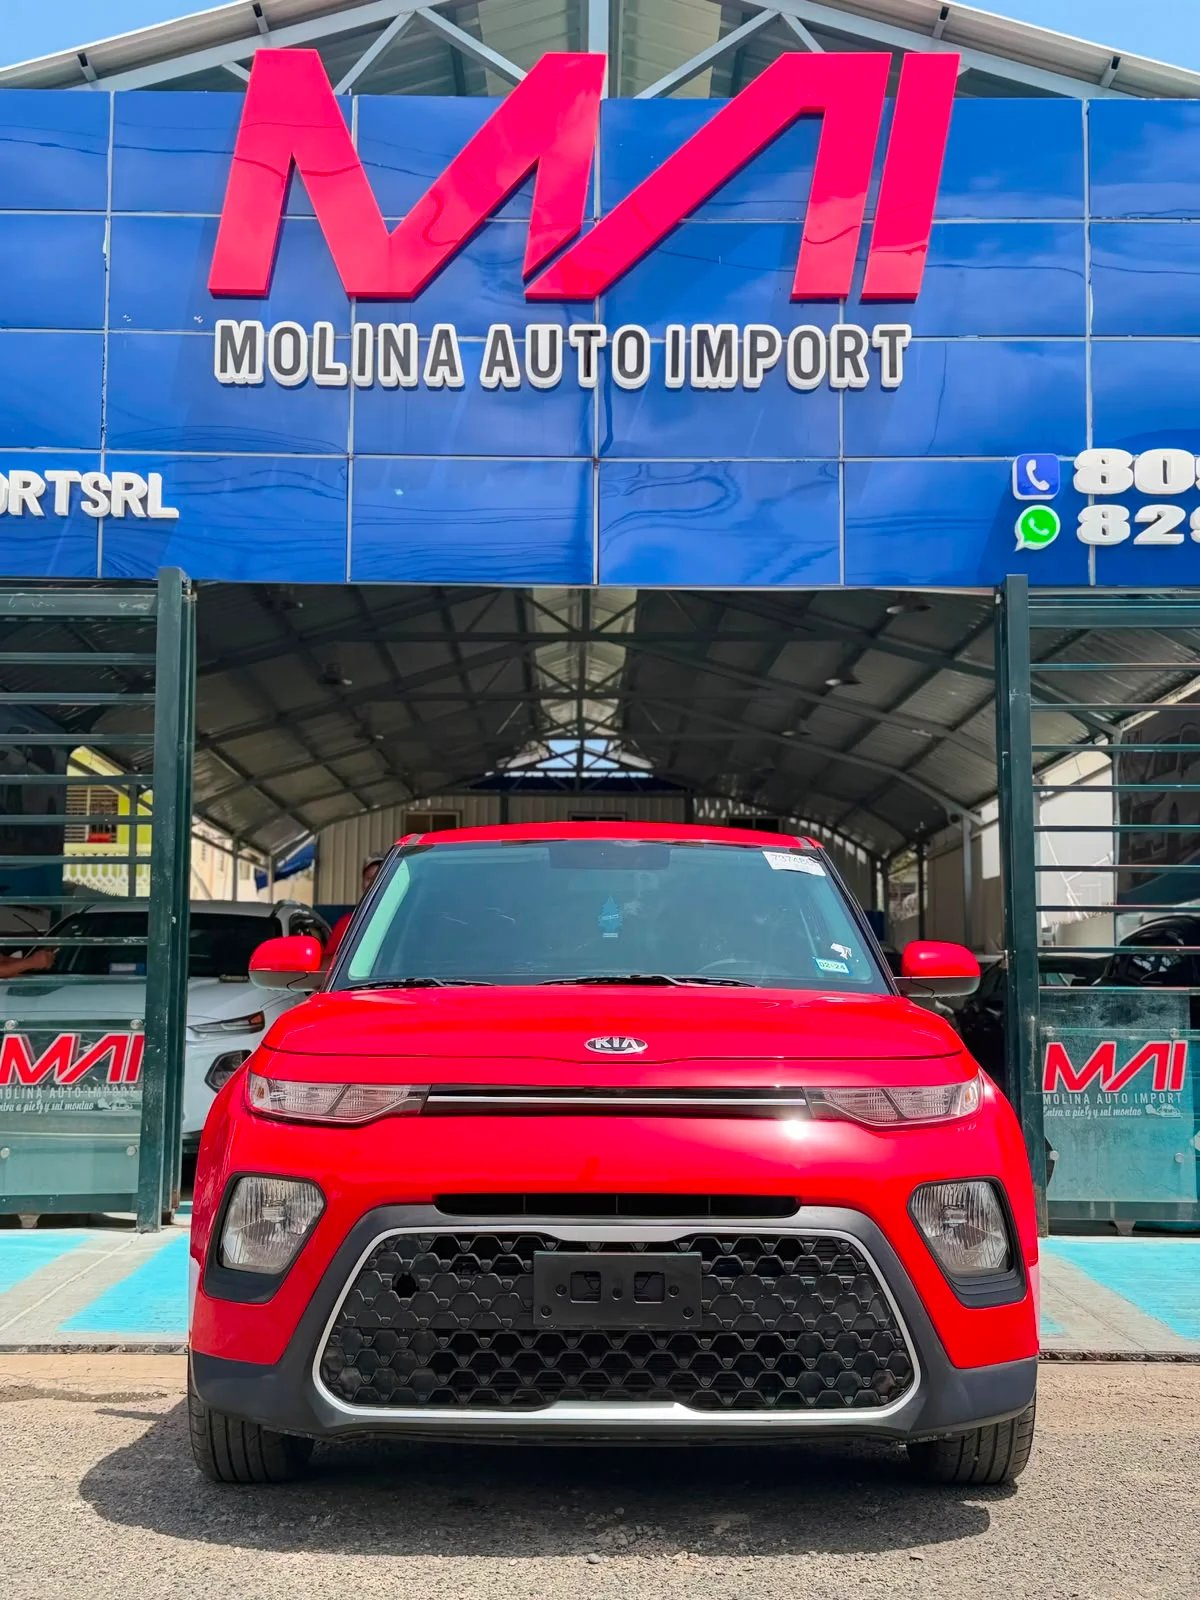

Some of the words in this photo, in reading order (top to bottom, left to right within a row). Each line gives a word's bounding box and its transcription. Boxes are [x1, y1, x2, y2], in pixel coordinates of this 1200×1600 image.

[208, 48, 960, 302] MAI
[214, 320, 464, 389] MOLINA
[480, 323, 650, 390] AUTO
[664, 323, 912, 390] IMPORT
[1073, 448, 1200, 495] 80
[1076, 504, 1200, 546] 82
[0, 1033, 145, 1085] MAI
[595, 1036, 640, 1050] KIA
[1042, 1040, 1188, 1093] MAI
[49, 1087, 81, 1099] AUTO
[87, 1086, 136, 1098] IMPORT
[1043, 1093, 1090, 1105] MOLINA
[1096, 1093, 1128, 1104] AUTO
[1134, 1092, 1183, 1104] IMPORT
